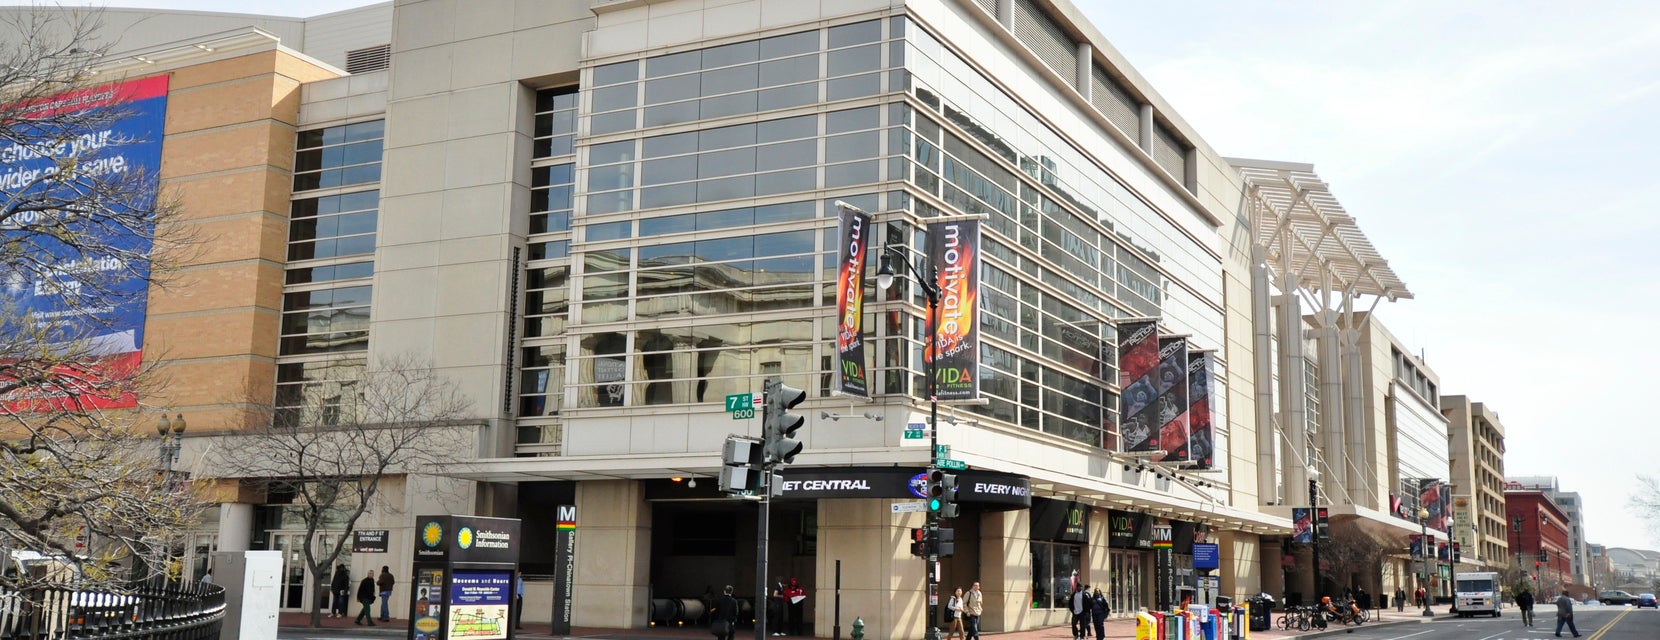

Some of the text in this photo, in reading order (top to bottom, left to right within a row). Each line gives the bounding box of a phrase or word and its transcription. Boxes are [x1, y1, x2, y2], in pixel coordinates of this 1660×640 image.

[69, 129, 112, 158] your
[847, 215, 862, 329] motivate
[944, 224, 966, 335] motivate
[929, 340, 973, 363] te spark.
[841, 359, 864, 379] VIDA
[729, 396, 738, 409] 7
[734, 409, 753, 419] 600
[803, 479, 871, 491] CENTRAL
[974, 482, 1030, 497] EVERY NIGH
[560, 506, 576, 521] M
[1066, 508, 1084, 526] VIDA
[1112, 516, 1133, 531] VIDA
[475, 529, 510, 540] Smithsonian
[566, 530, 575, 554] Gallery
[1160, 528, 1172, 541] M
[475, 538, 509, 549] Information
[563, 598, 571, 623] Station
